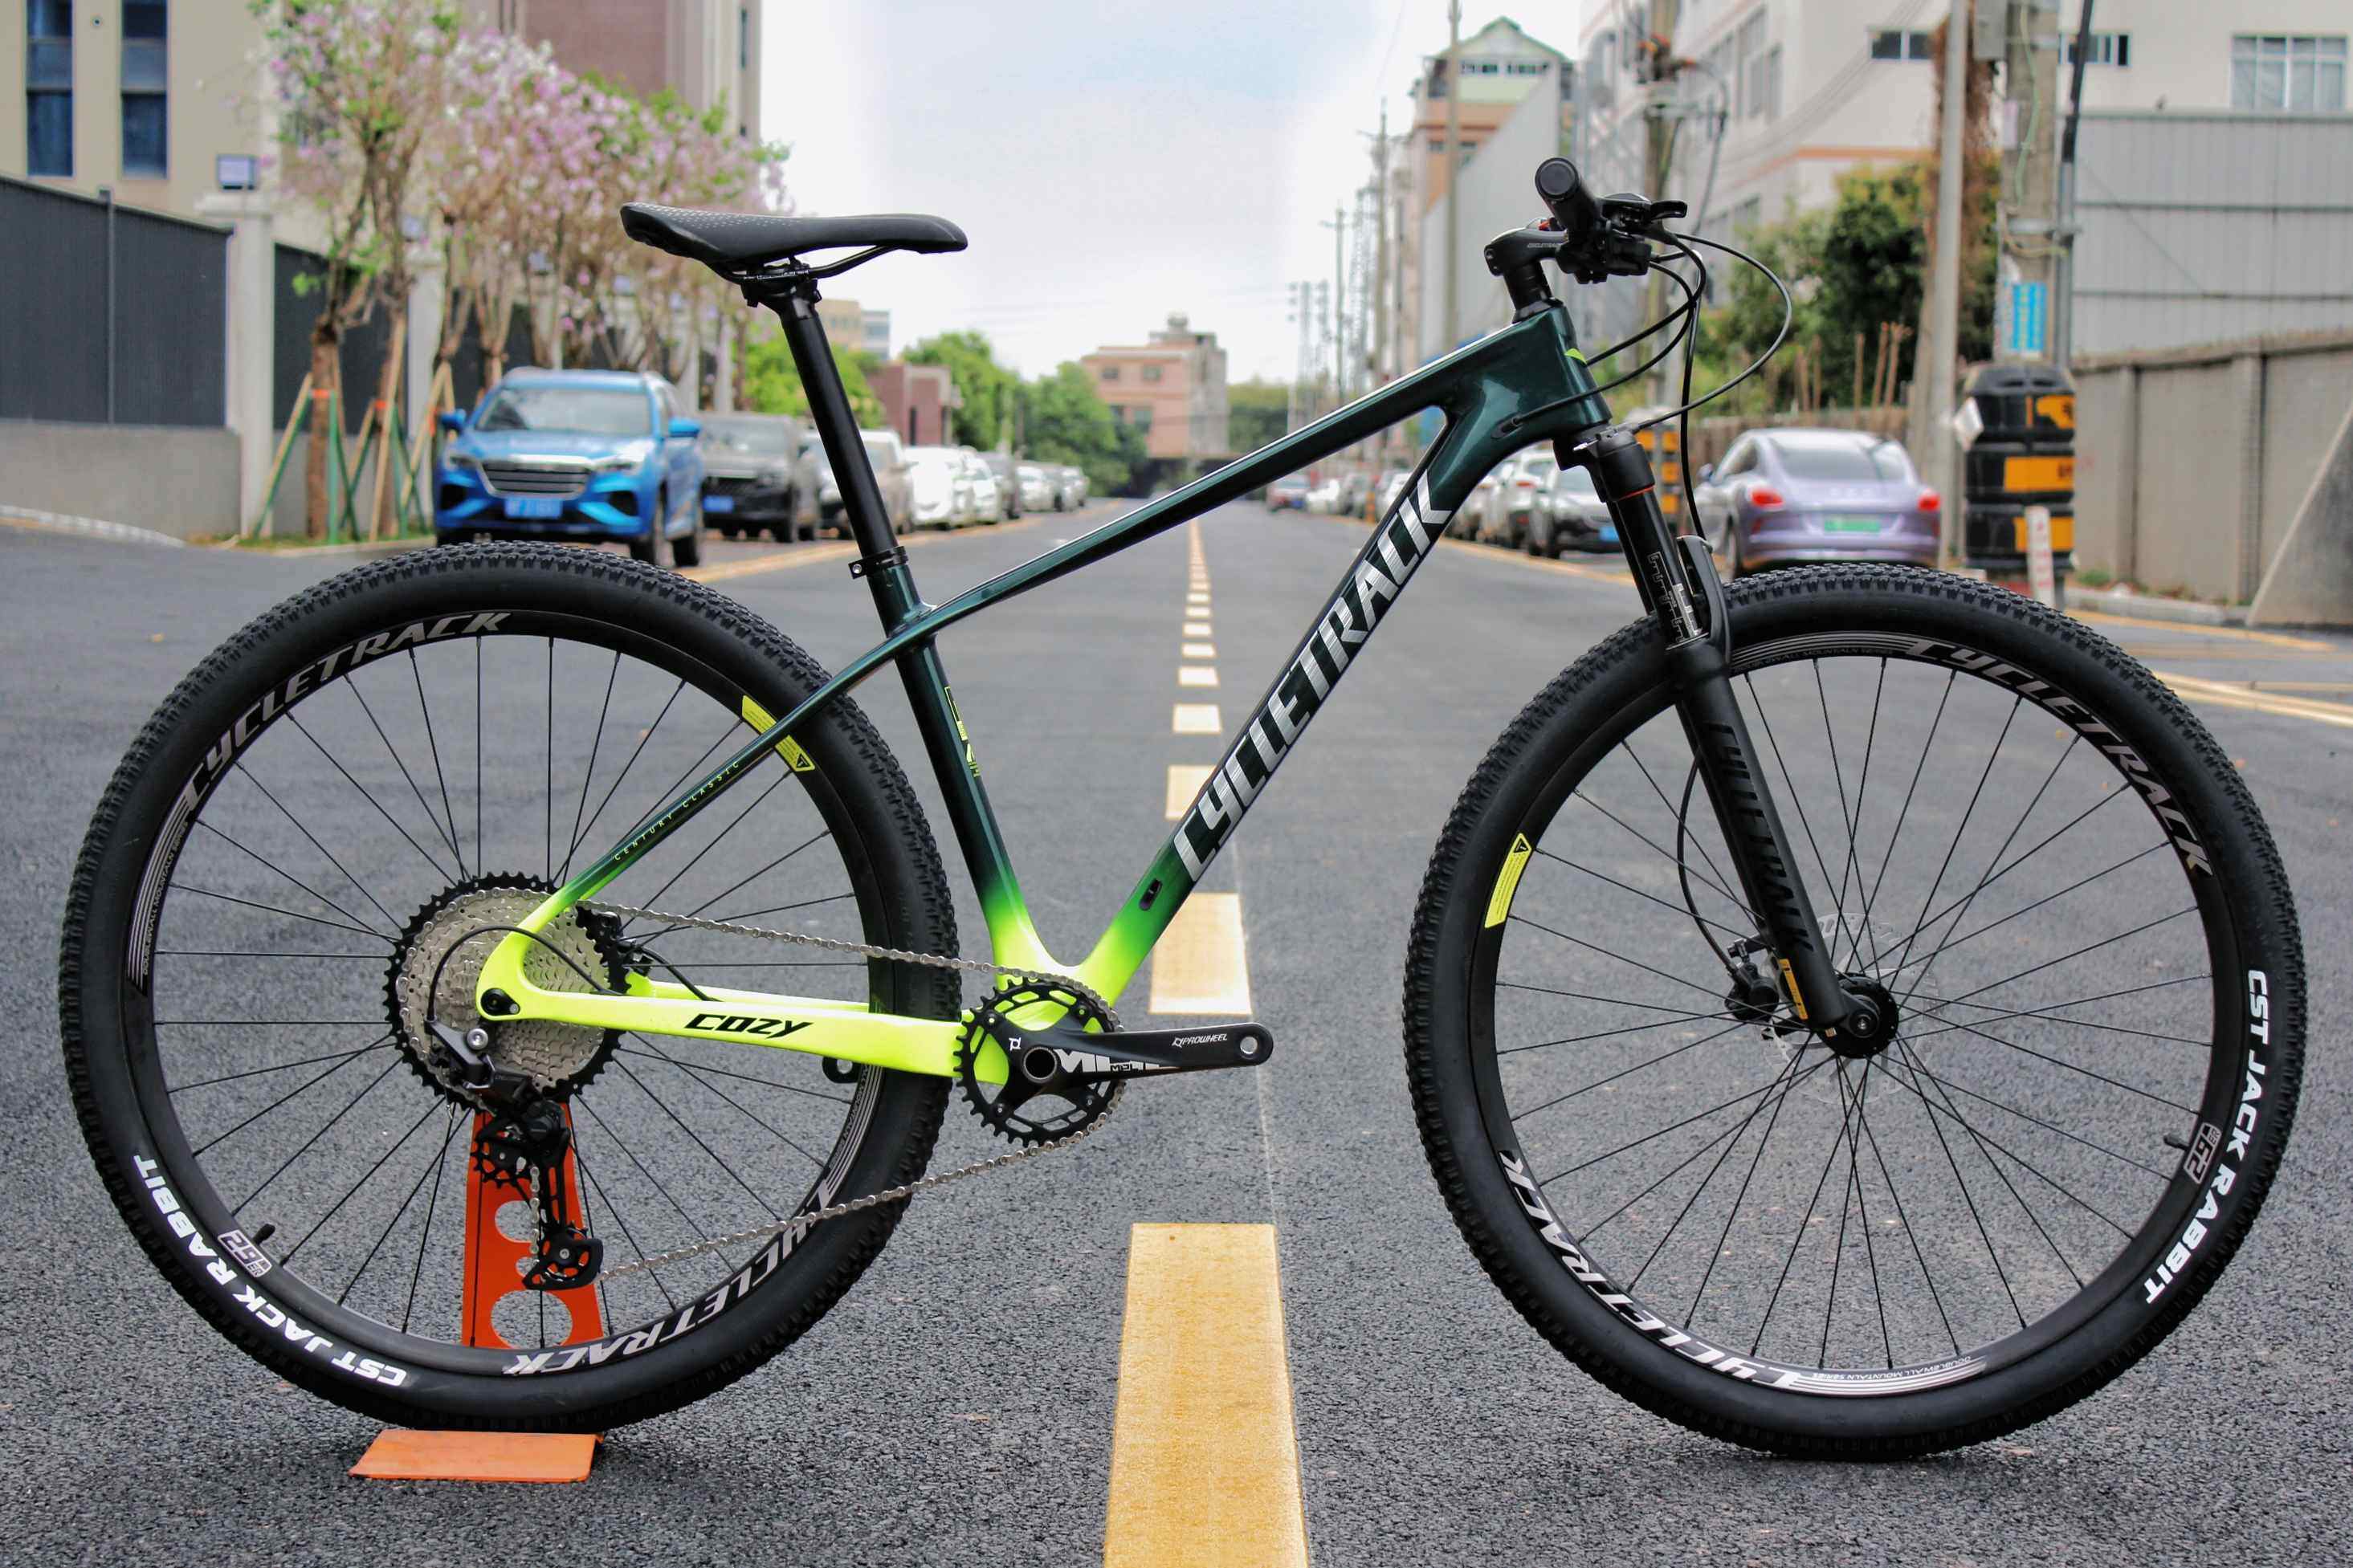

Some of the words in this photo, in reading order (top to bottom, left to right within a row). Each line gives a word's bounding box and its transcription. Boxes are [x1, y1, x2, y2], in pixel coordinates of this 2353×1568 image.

[185, 613, 512, 811] CYCLETRACK
[1173, 469, 1452, 882] CYCLETRACK
[614, 813, 673, 861] CENTURY
[683, 761, 739, 808] CLASSIC
[1905, 639, 2213, 875] CYCLETRACK
[683, 1013, 814, 1039] COZY
[1182, 1033, 1227, 1045] PROWHEEL
[2248, 969, 2269, 1044] CST
[2226, 1050, 2266, 1161] JACK
[133, 1155, 238, 1285] RABBIT
[1499, 1152, 1800, 1388] CYCLETRACK
[2144, 1163, 2237, 1304] RABBIT
[232, 1285, 333, 1353] JACK
[503, 1179, 830, 1375] CYCLETRACK
[331, 1351, 407, 1387] CST
[1904, 1356, 1972, 1375] DOUBLEWALL
